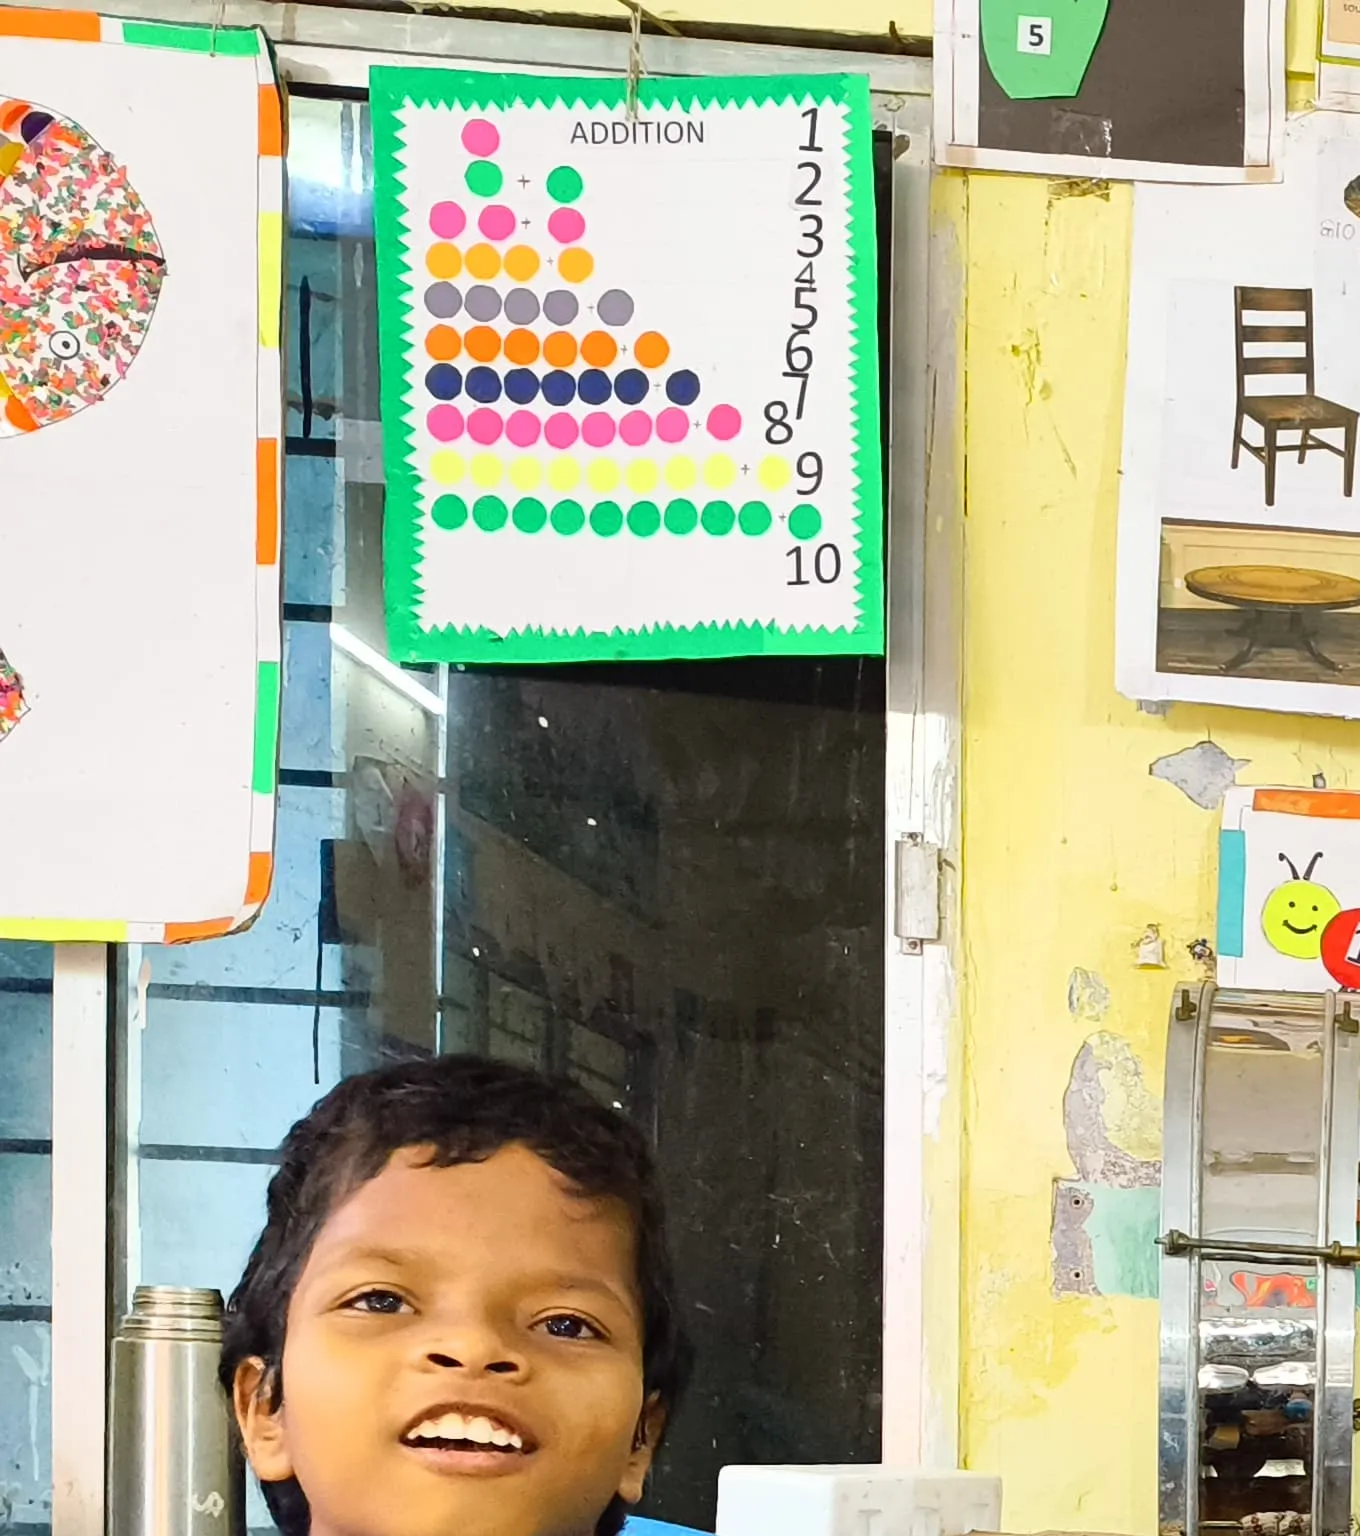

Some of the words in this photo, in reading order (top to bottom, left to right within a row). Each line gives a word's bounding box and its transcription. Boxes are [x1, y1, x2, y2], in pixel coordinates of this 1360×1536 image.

[1028, 23, 1045, 47] 5
[570, 120, 705, 145] ADDITION
[798, 107, 824, 153] 1
[794, 160, 823, 206] 2
[796, 213, 824, 258] 3
[794, 261, 816, 290] 4
[790, 286, 819, 331] 5
[785, 329, 814, 373] 6
[781, 371, 810, 420] 7
[763, 400, 794, 445] 8
[795, 451, 824, 496] 9
[785, 543, 842, 587] 10
